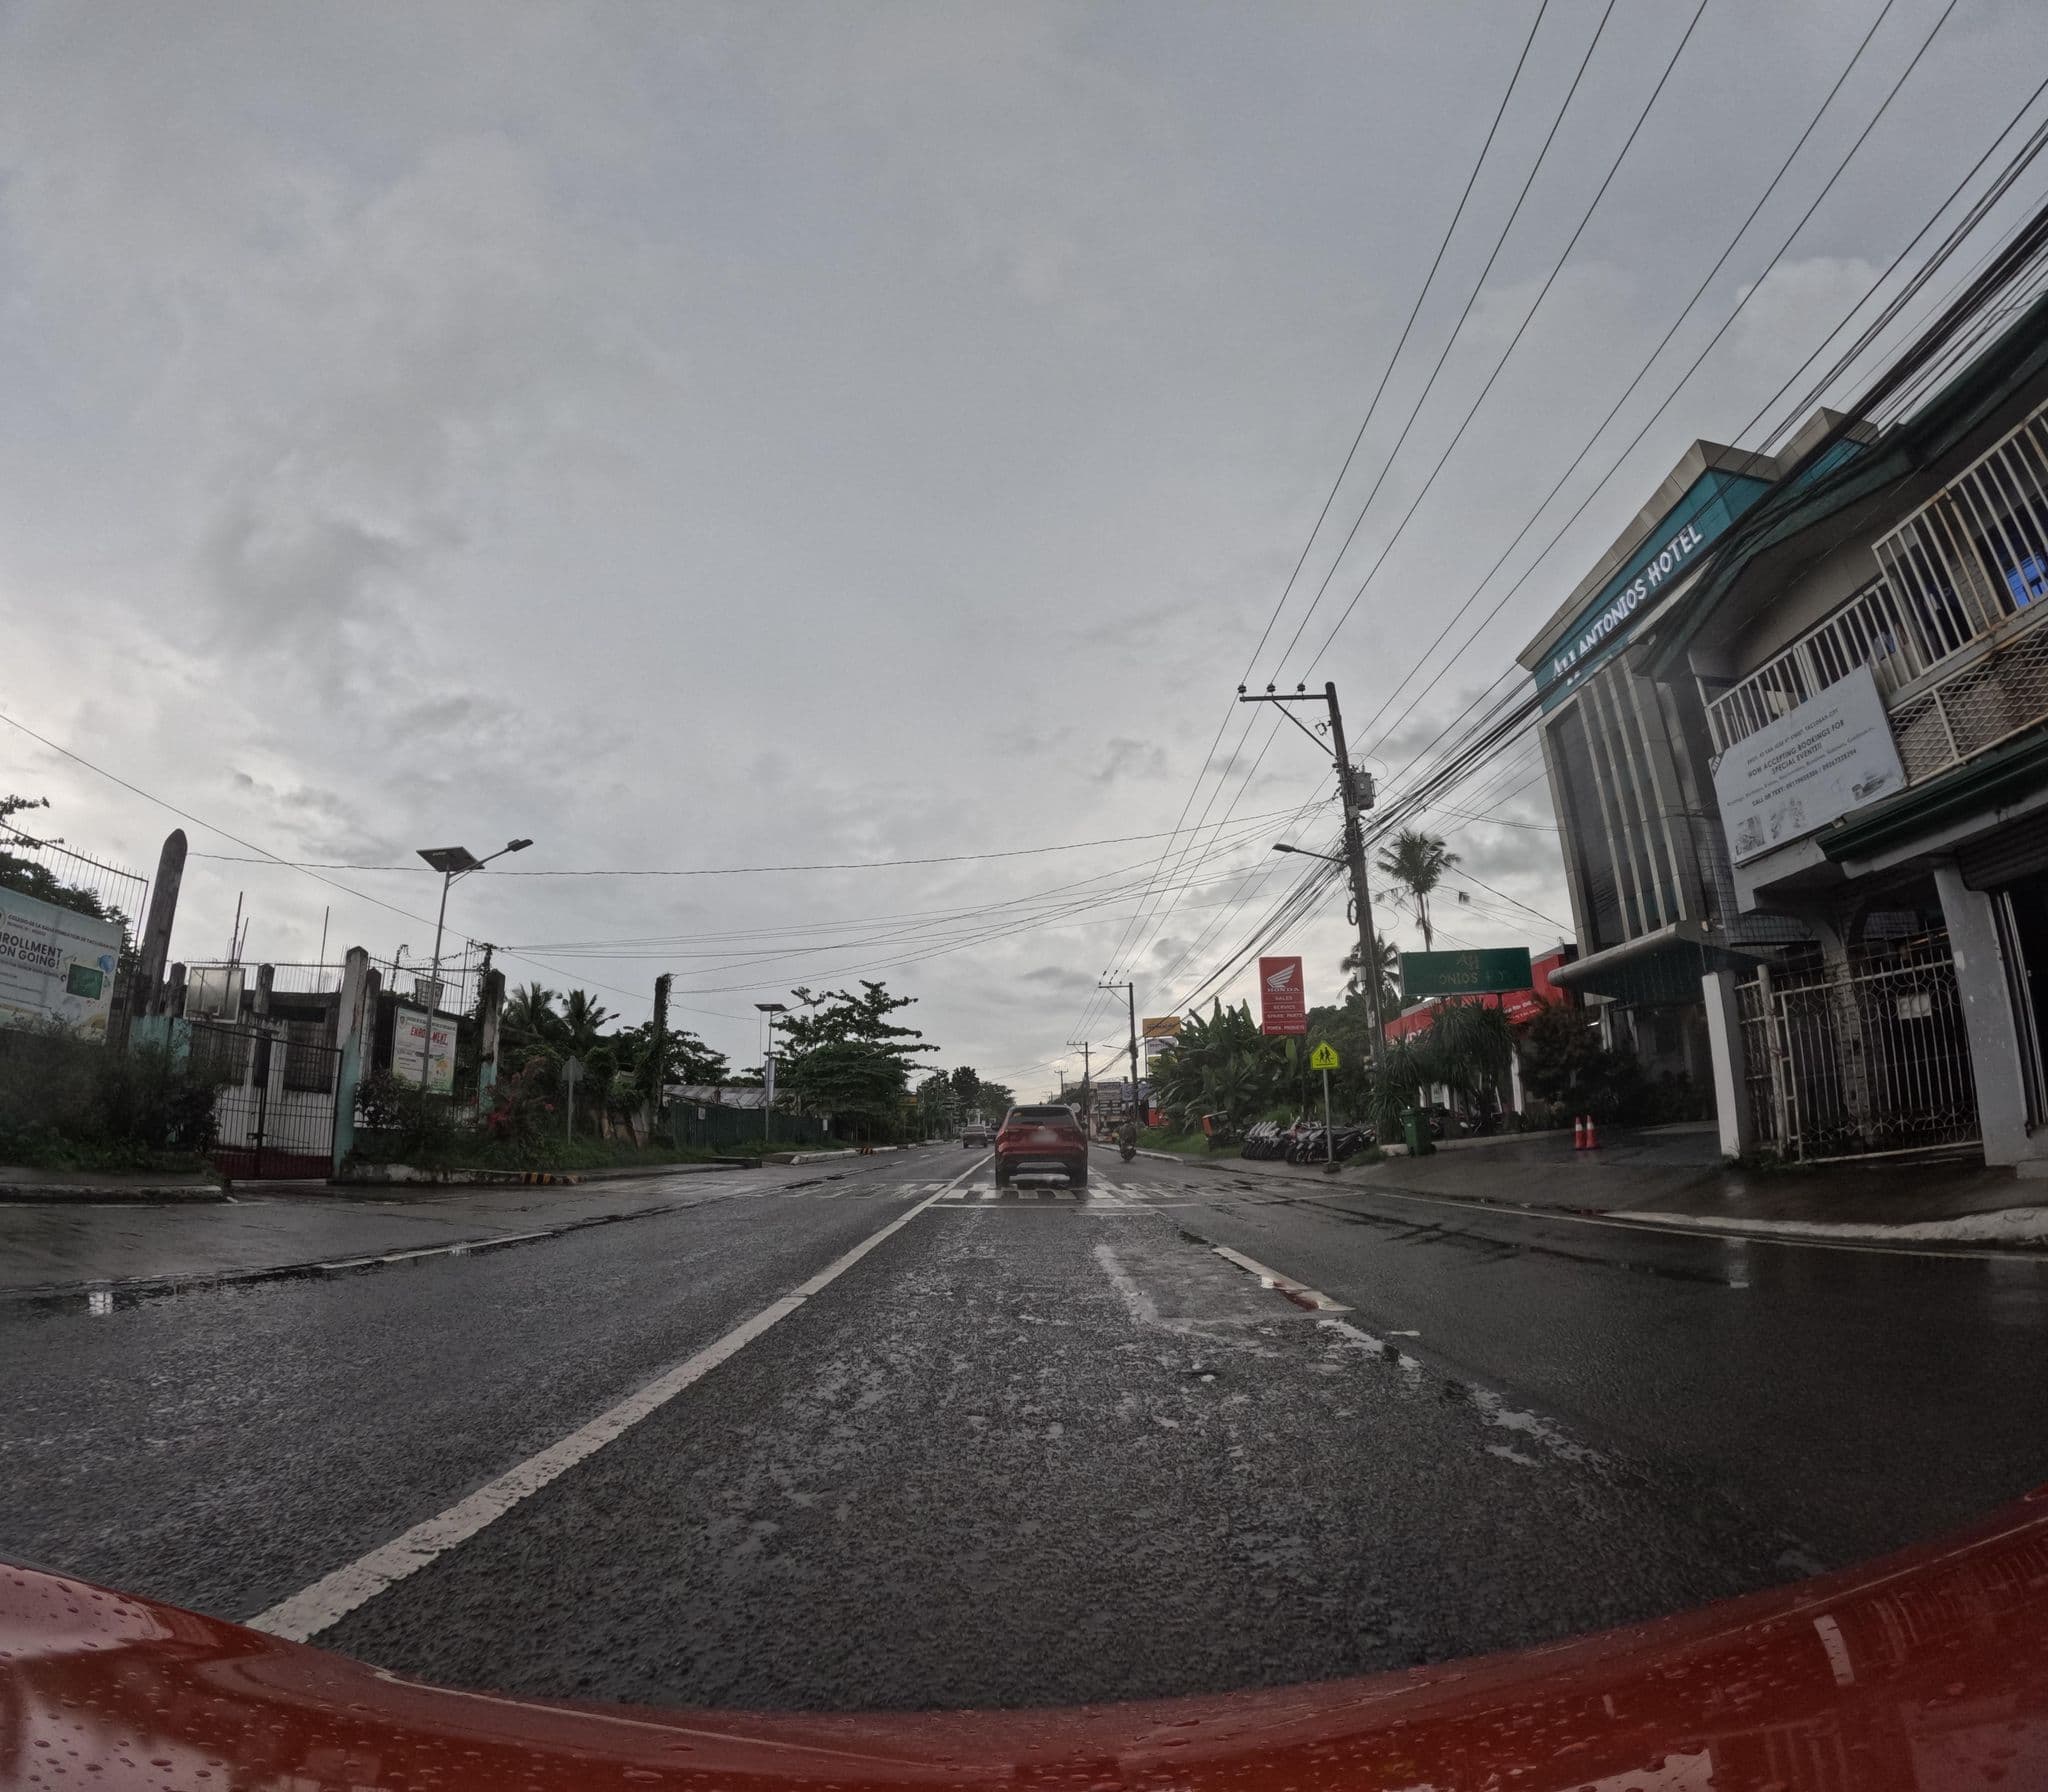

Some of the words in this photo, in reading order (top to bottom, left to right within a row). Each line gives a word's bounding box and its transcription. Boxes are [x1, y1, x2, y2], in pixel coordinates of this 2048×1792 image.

[1578, 577, 1648, 655] ANTONIOS
[1647, 523, 1704, 586] HOTEL
[1748, 766, 1763, 778] NOW
[1763, 746, 1797, 770] ACCEPTING
[1797, 728, 1831, 751] BOOKINGS
[1831, 719, 1845, 732] FOR
[1771, 757, 1796, 775] SPECIAL
[1752, 797, 1765, 807] CALL
[0, 931, 63, 958] ROLLMENT
[0, 944, 16, 957] ON
[18, 949, 60, 969] GOING!
